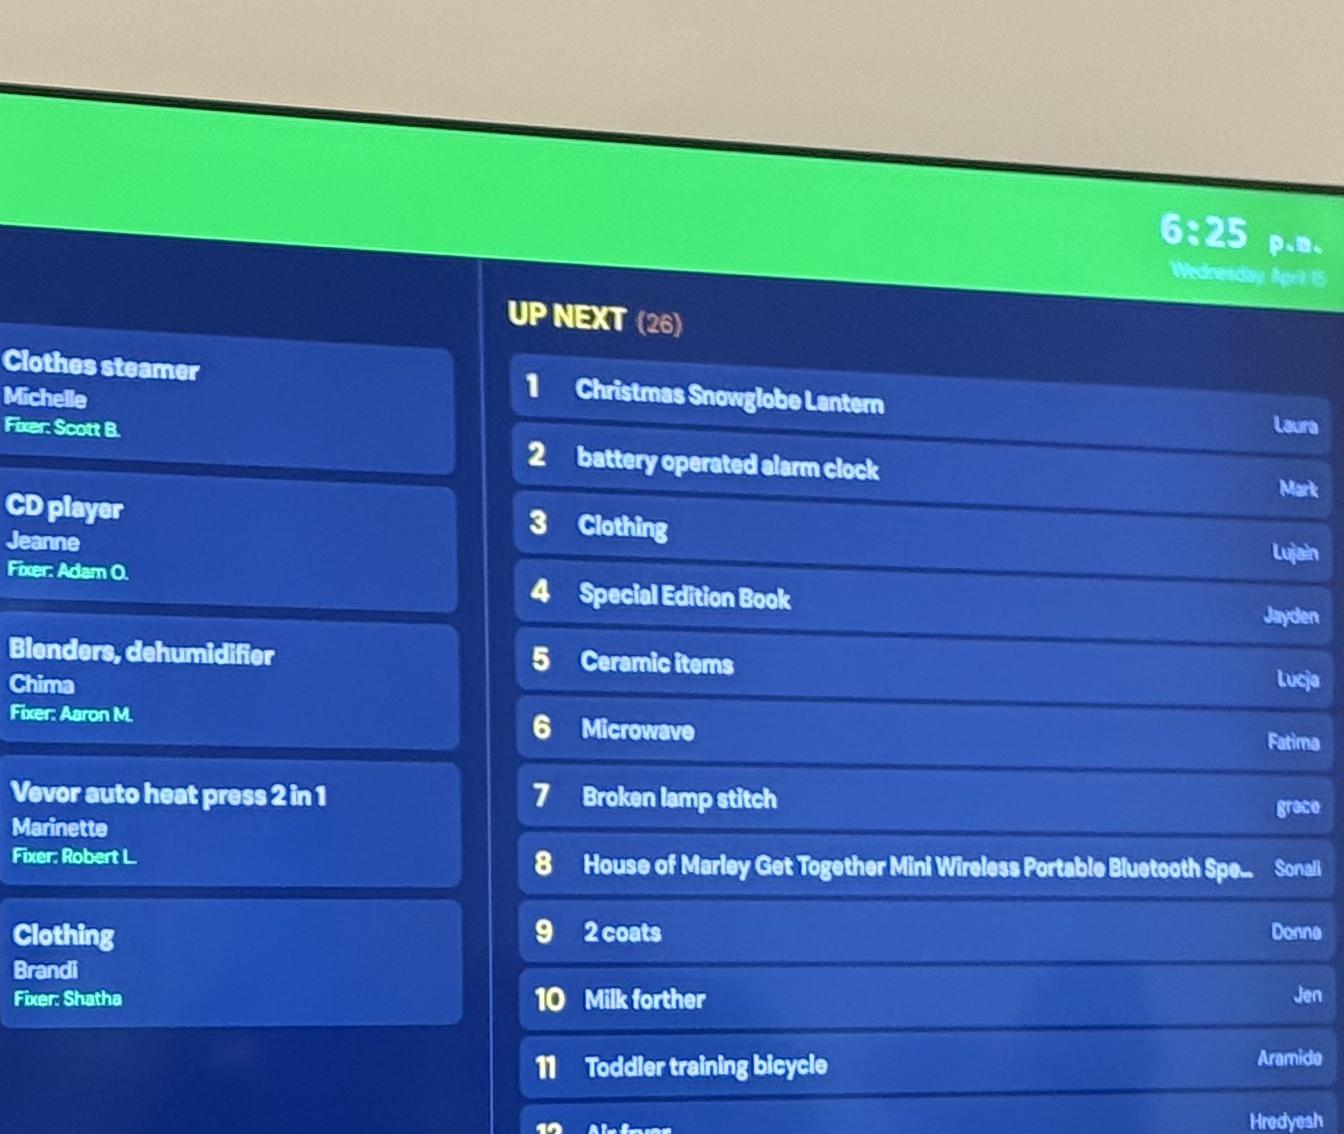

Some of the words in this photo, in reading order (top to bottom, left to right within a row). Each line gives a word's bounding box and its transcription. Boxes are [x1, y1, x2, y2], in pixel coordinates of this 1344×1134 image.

[1160, 213, 1248, 248] 6:25
[507, 300, 547, 327] UP
[553, 303, 626, 331] NEXT
[636, 310, 682, 337] (26)
[2, 350, 96, 376] Clothes
[101, 357, 199, 381] steamer
[4, 387, 87, 409] Michelle
[526, 373, 538, 398] 1
[575, 378, 684, 404] Christmas
[688, 384, 800, 413] Snowglobe
[805, 390, 884, 414] Lantern
[1274, 415, 1319, 435] Laura
[528, 441, 546, 466] 2
[577, 446, 657, 475] battery
[661, 453, 756, 476] operated
[761, 457, 820, 478] alarm
[824, 457, 879, 481] clock
[1280, 478, 1319, 499] Mark
[5, 493, 43, 516] CD
[47, 496, 123, 524] player
[529, 510, 547, 534] 3
[577, 514, 668, 543] Clothing
[6, 531, 80, 551] Jeanne
[531, 578, 550, 602] 4
[579, 582, 657, 608] Special
[662, 585, 734, 607] Edition
[740, 588, 791, 610] Book
[1264, 606, 1319, 627] Jayden
[9, 637, 121, 665] Blenders,
[125, 641, 275, 666] dehumidifier
[532, 646, 550, 671] 5
[581, 650, 670, 675] Ceramic
[675, 652, 734, 675] items
[10, 674, 74, 694] Chima
[532, 714, 550, 739] 6
[582, 718, 694, 742] Microwave
[1268, 732, 1320, 752] Fatima
[11, 781, 80, 802] Vevor
[85, 785, 139, 804] auto
[144, 782, 198, 804] heat
[202, 786, 266, 810] press
[271, 786, 286, 805] 2
[290, 785, 311, 805] in
[316, 786, 326, 806] 1
[532, 783, 550, 807] 7
[582, 786, 656, 808] Broken
[661, 787, 713, 813] lamp
[717, 787, 777, 809] stitch
[1277, 799, 1320, 818] grace
[12, 818, 107, 838] Marinette
[535, 850, 552, 875] 8
[584, 854, 650, 876] House
[655, 854, 676, 876] of
[681, 855, 751, 881] Marley
[756, 856, 793, 876] Get
[798, 856, 885, 881] Together
[890, 856, 931, 877] Mini
[936, 857, 1020, 879] Wireless
[1024, 858, 1105, 879] Portable
[1109, 858, 1200, 879] Bluetooth
[1275, 858, 1321, 878] Sonali
[13, 924, 115, 951] Clothing
[536, 919, 553, 943] 9
[584, 922, 598, 942] 2
[602, 922, 661, 942] coats
[1272, 923, 1321, 941] Donna
[14, 961, 77, 981] Brandi
[535, 987, 565, 1011] 10
[585, 989, 627, 1009] Milk
[632, 988, 706, 1009] forther
[1294, 986, 1322, 1004] Jen
[536, 1055, 556, 1079] 11
[585, 1056, 665, 1078] Toddler
[670, 1055, 748, 1080] training
[753, 1054, 827, 1080] bicycle
[1258, 1049, 1322, 1066] Aramide
[1250, 1112, 1323, 1133] Hredyesh
